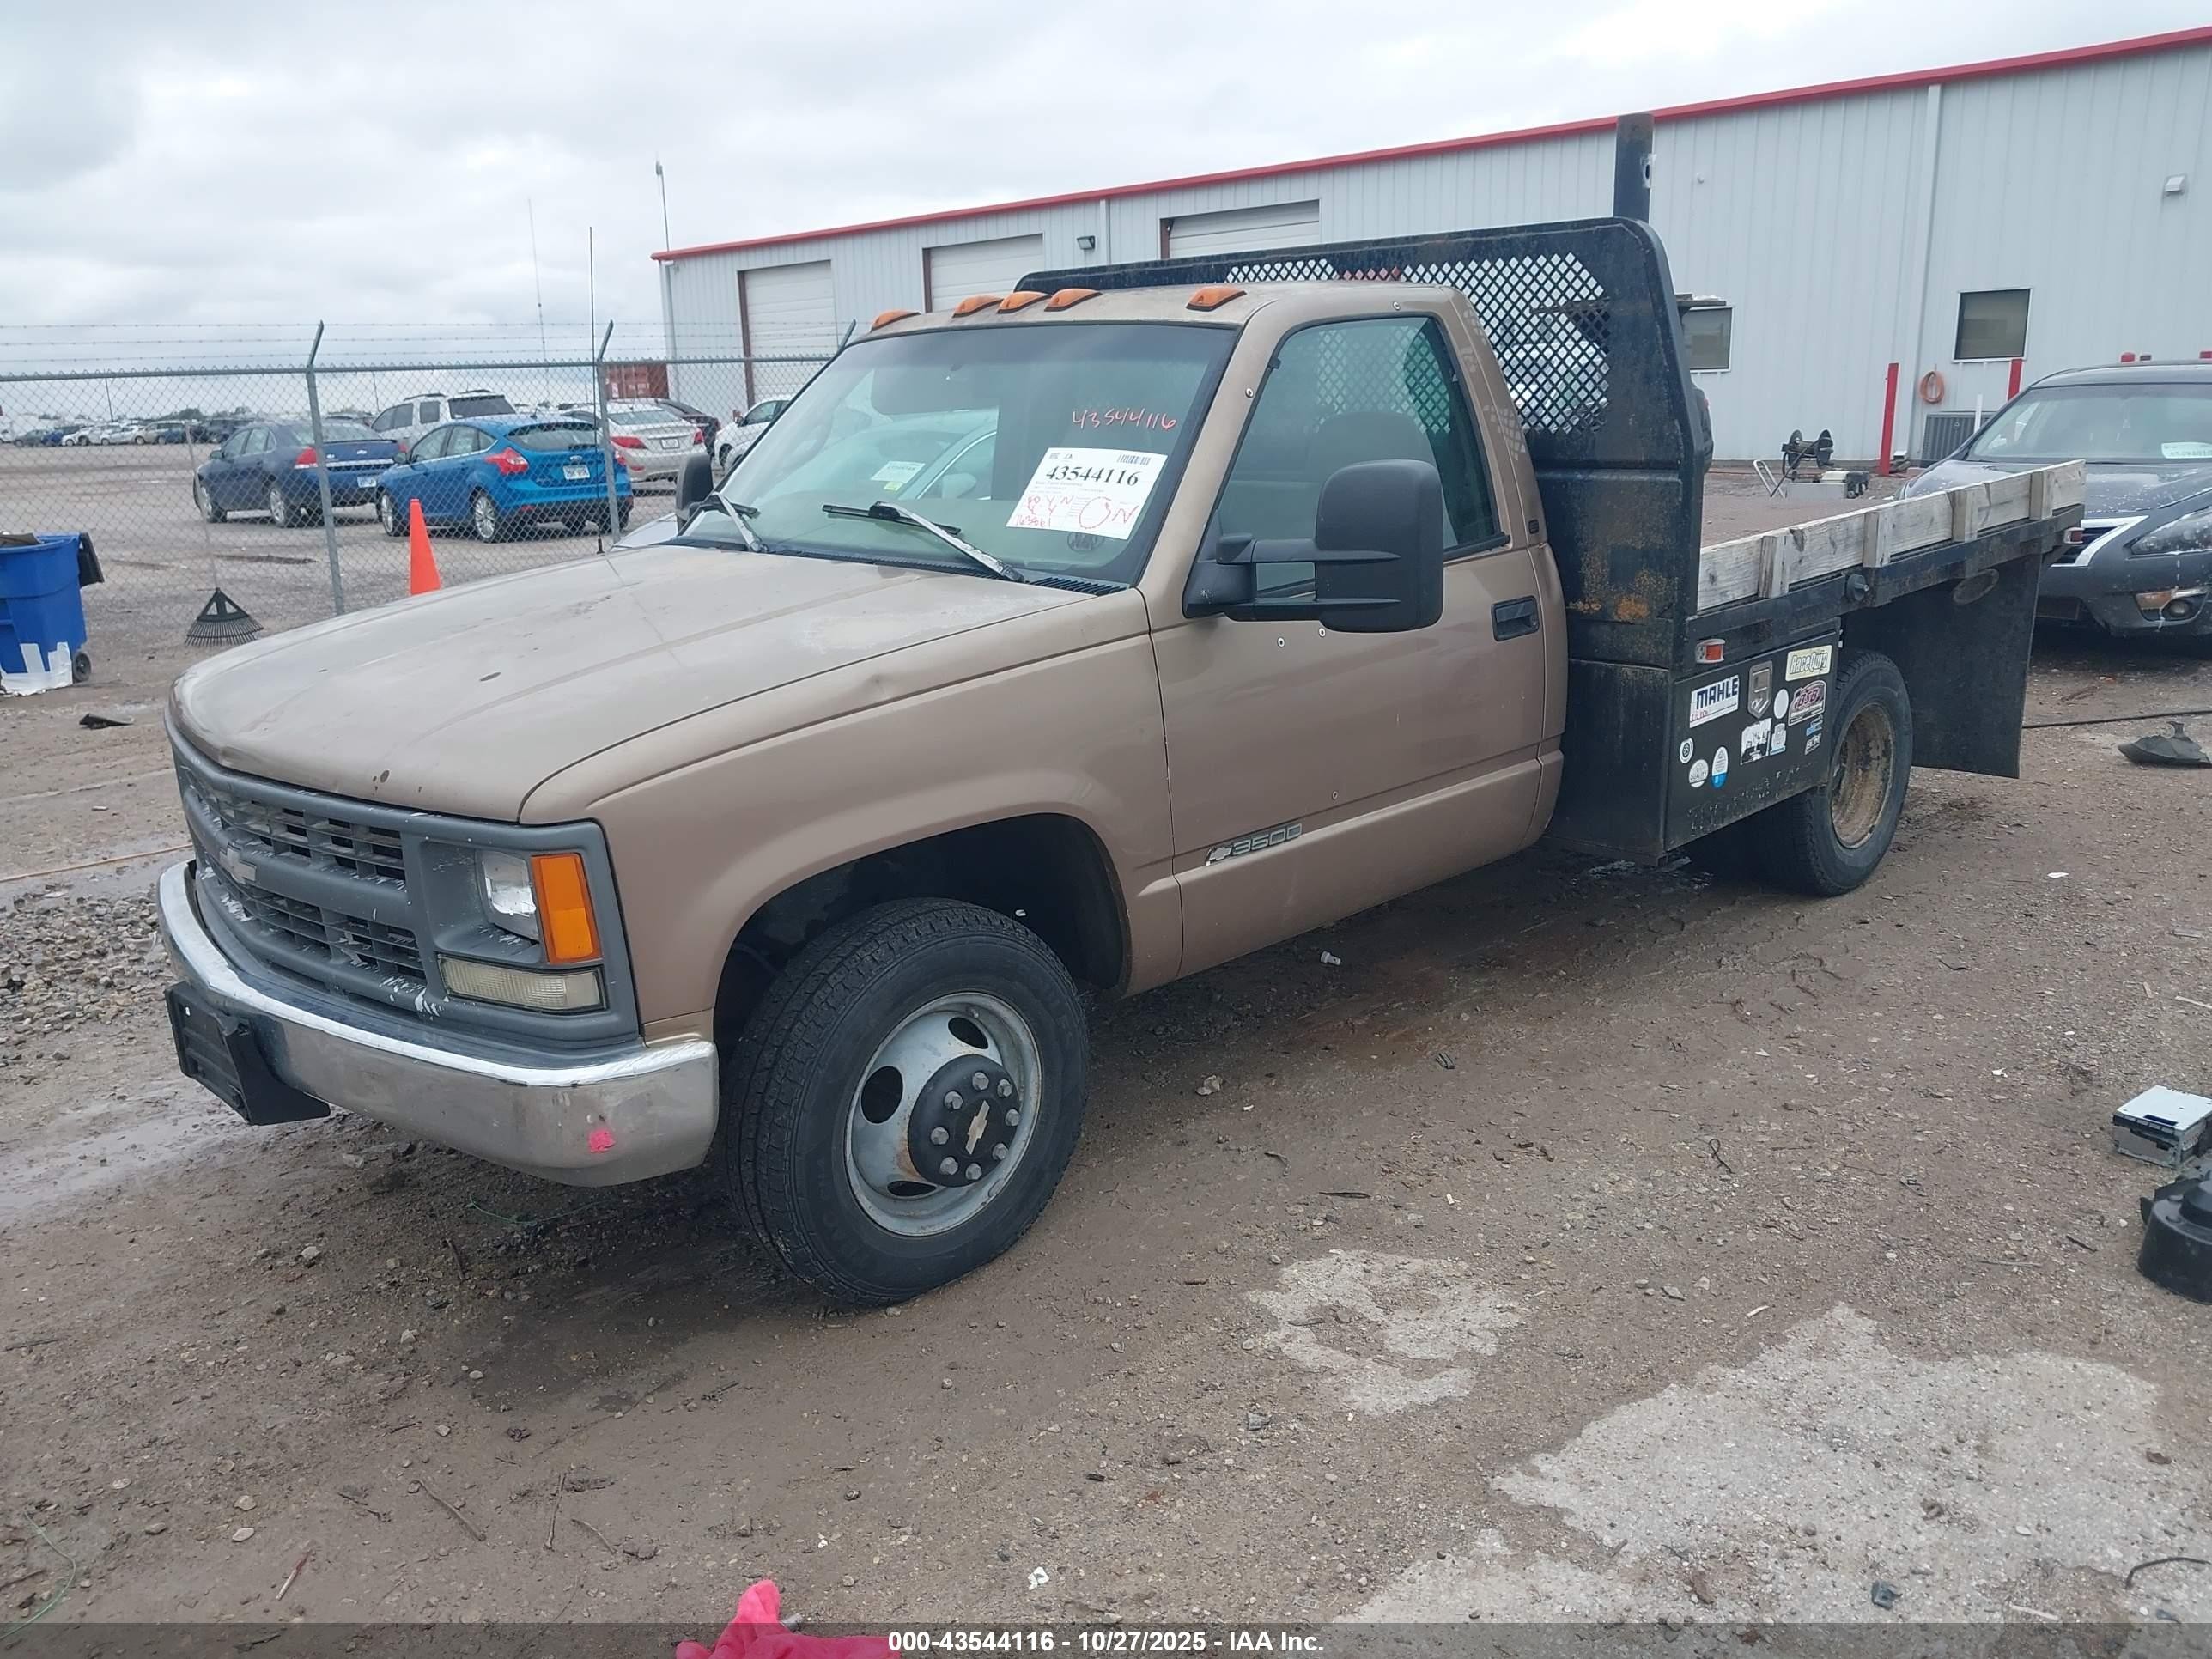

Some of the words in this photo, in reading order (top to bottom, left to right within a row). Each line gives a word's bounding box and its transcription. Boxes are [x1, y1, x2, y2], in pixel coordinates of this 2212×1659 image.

[1073, 407, 1177, 430] 43544116
[1046, 465, 1142, 487] 43544116
[1790, 651, 1829, 675] RaceQuip
[1696, 677, 1739, 710] MAHLE
[1231, 823, 1303, 856] 3500
